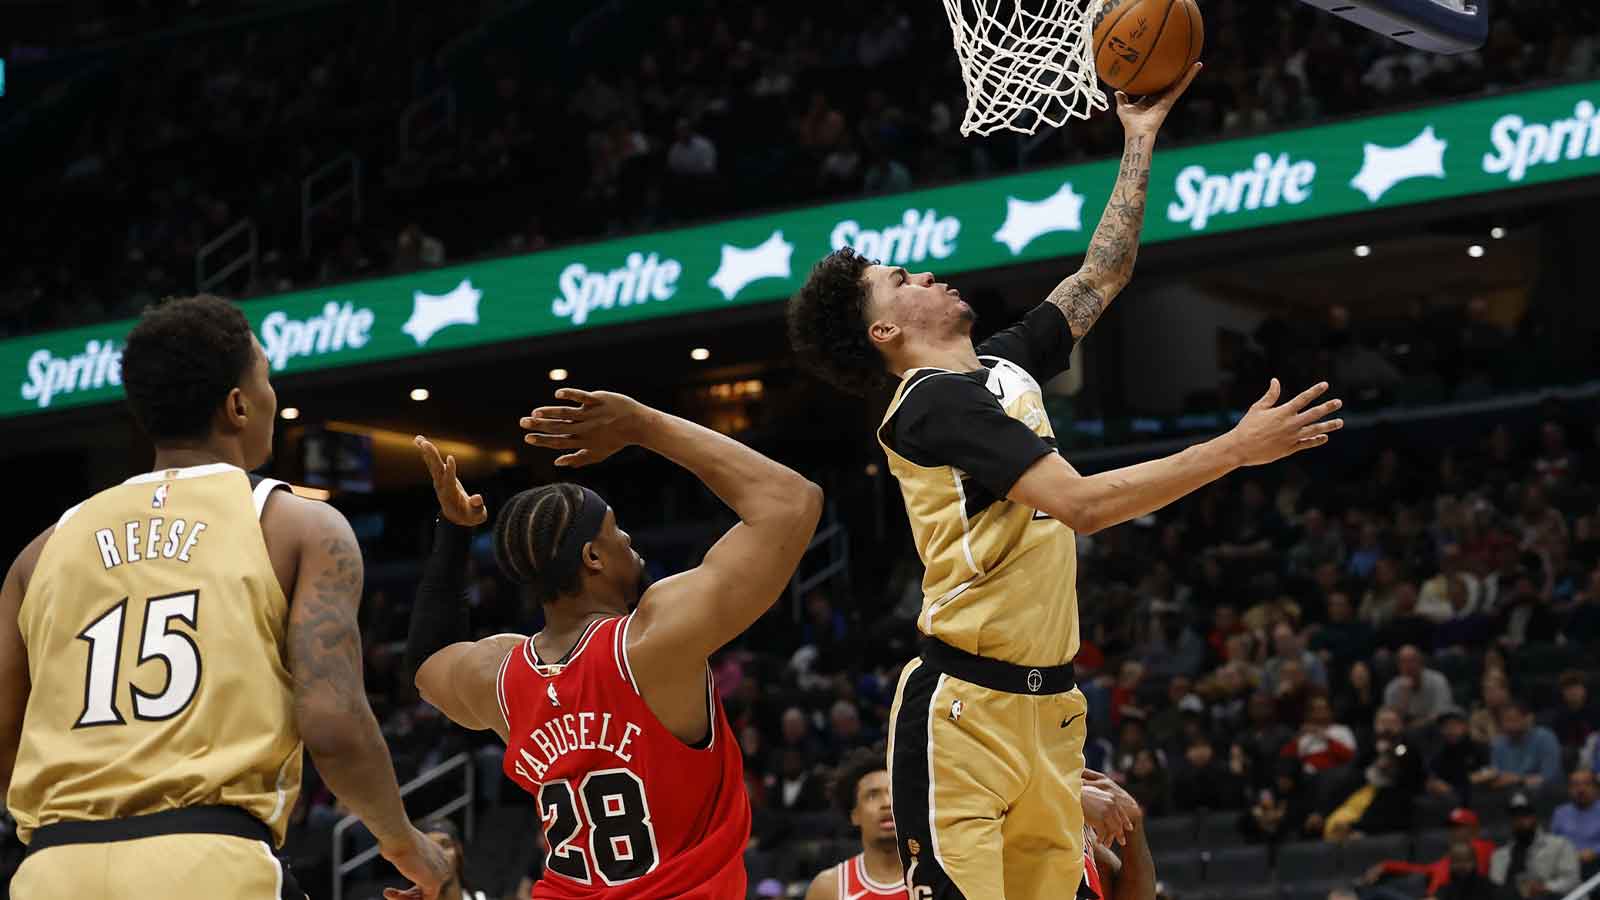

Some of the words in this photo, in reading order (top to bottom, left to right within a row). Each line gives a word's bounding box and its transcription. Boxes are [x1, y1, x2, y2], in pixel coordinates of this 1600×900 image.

[1167, 152, 1316, 230] Sprite
[830, 208, 961, 266] Sprite
[552, 252, 682, 325] Sprite
[260, 301, 375, 371] Sprite
[95, 517, 208, 569] REESE
[71, 589, 203, 730] 15
[515, 712, 642, 785] YABUSELE
[537, 767, 660, 887] 28
